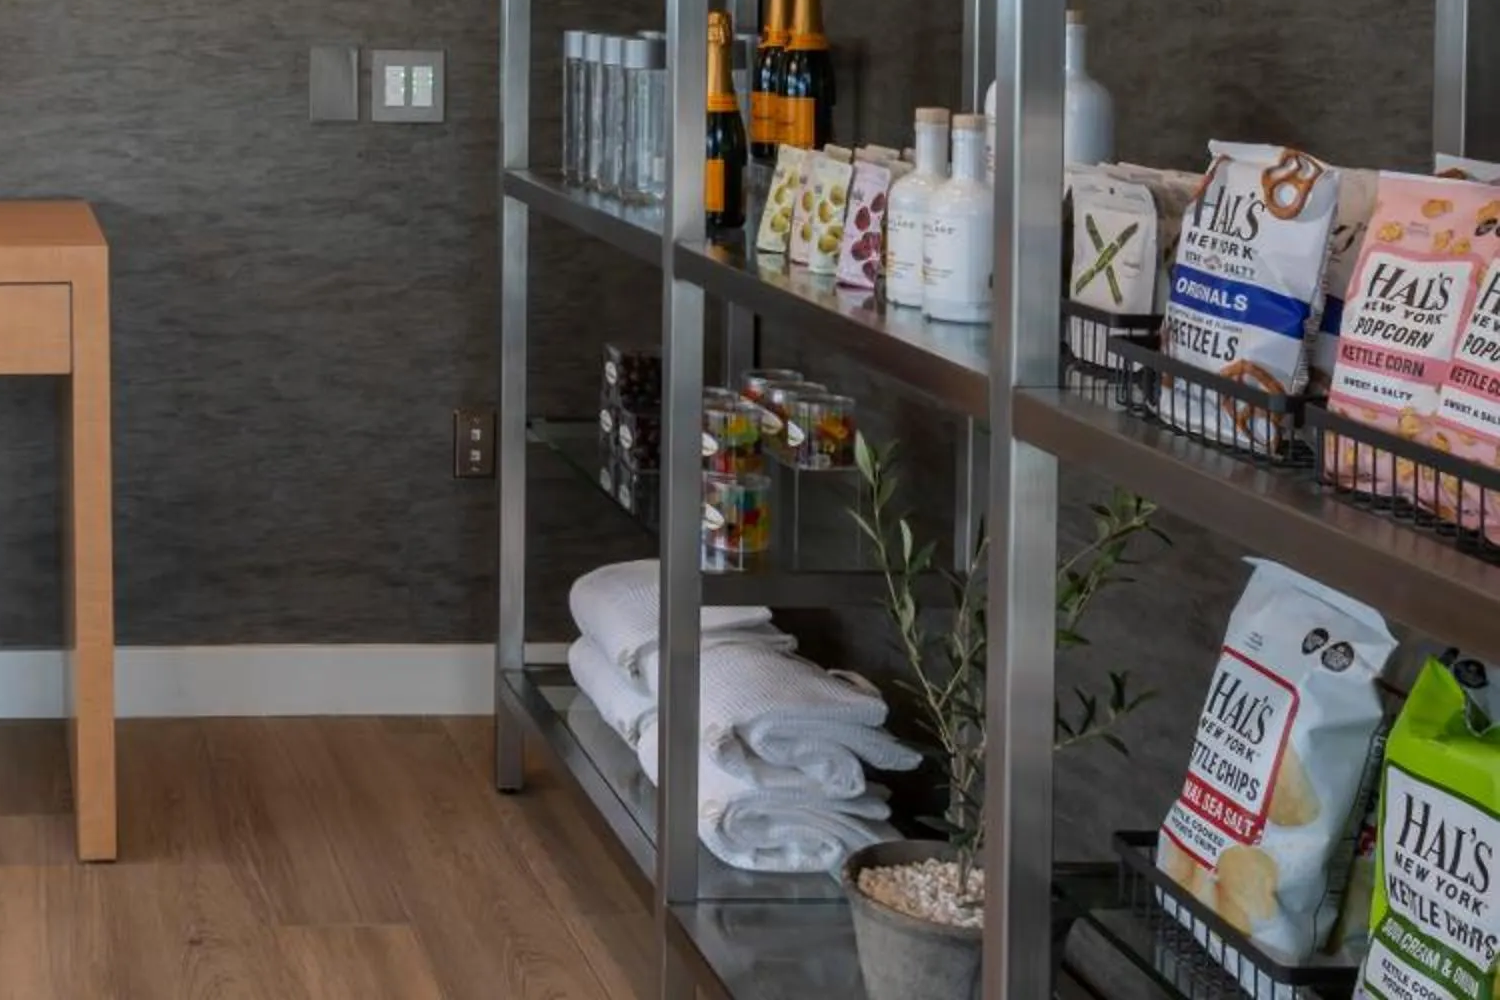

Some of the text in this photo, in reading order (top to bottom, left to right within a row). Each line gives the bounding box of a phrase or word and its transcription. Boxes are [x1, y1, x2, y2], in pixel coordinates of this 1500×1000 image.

[1176, 277, 1248, 312] ORNALS
[1367, 262, 1454, 311] HAL'S
[1363, 301, 1444, 325] NEW YORK
[1353, 316, 1434, 349] POPCORN
[1462, 333, 1500, 362] POPC
[1342, 344, 1425, 377] KETTLE CORN
[1450, 364, 1489, 391] KETTLE
[1481, 410, 1500, 426] SAL
[1207, 671, 1274, 746] HAL'S
[1201, 717, 1255, 764] NEW YORK
[1191, 740, 1219, 775] TTLE
[1216, 758, 1261, 802] CHIPS
[1201, 793, 1255, 838] SEA SALT
[1396, 791, 1493, 895] HAL'S
[1394, 851, 1485, 917] NEW YORK
[1440, 957, 1454, 979] &
[1411, 980, 1444, 1000] COO
